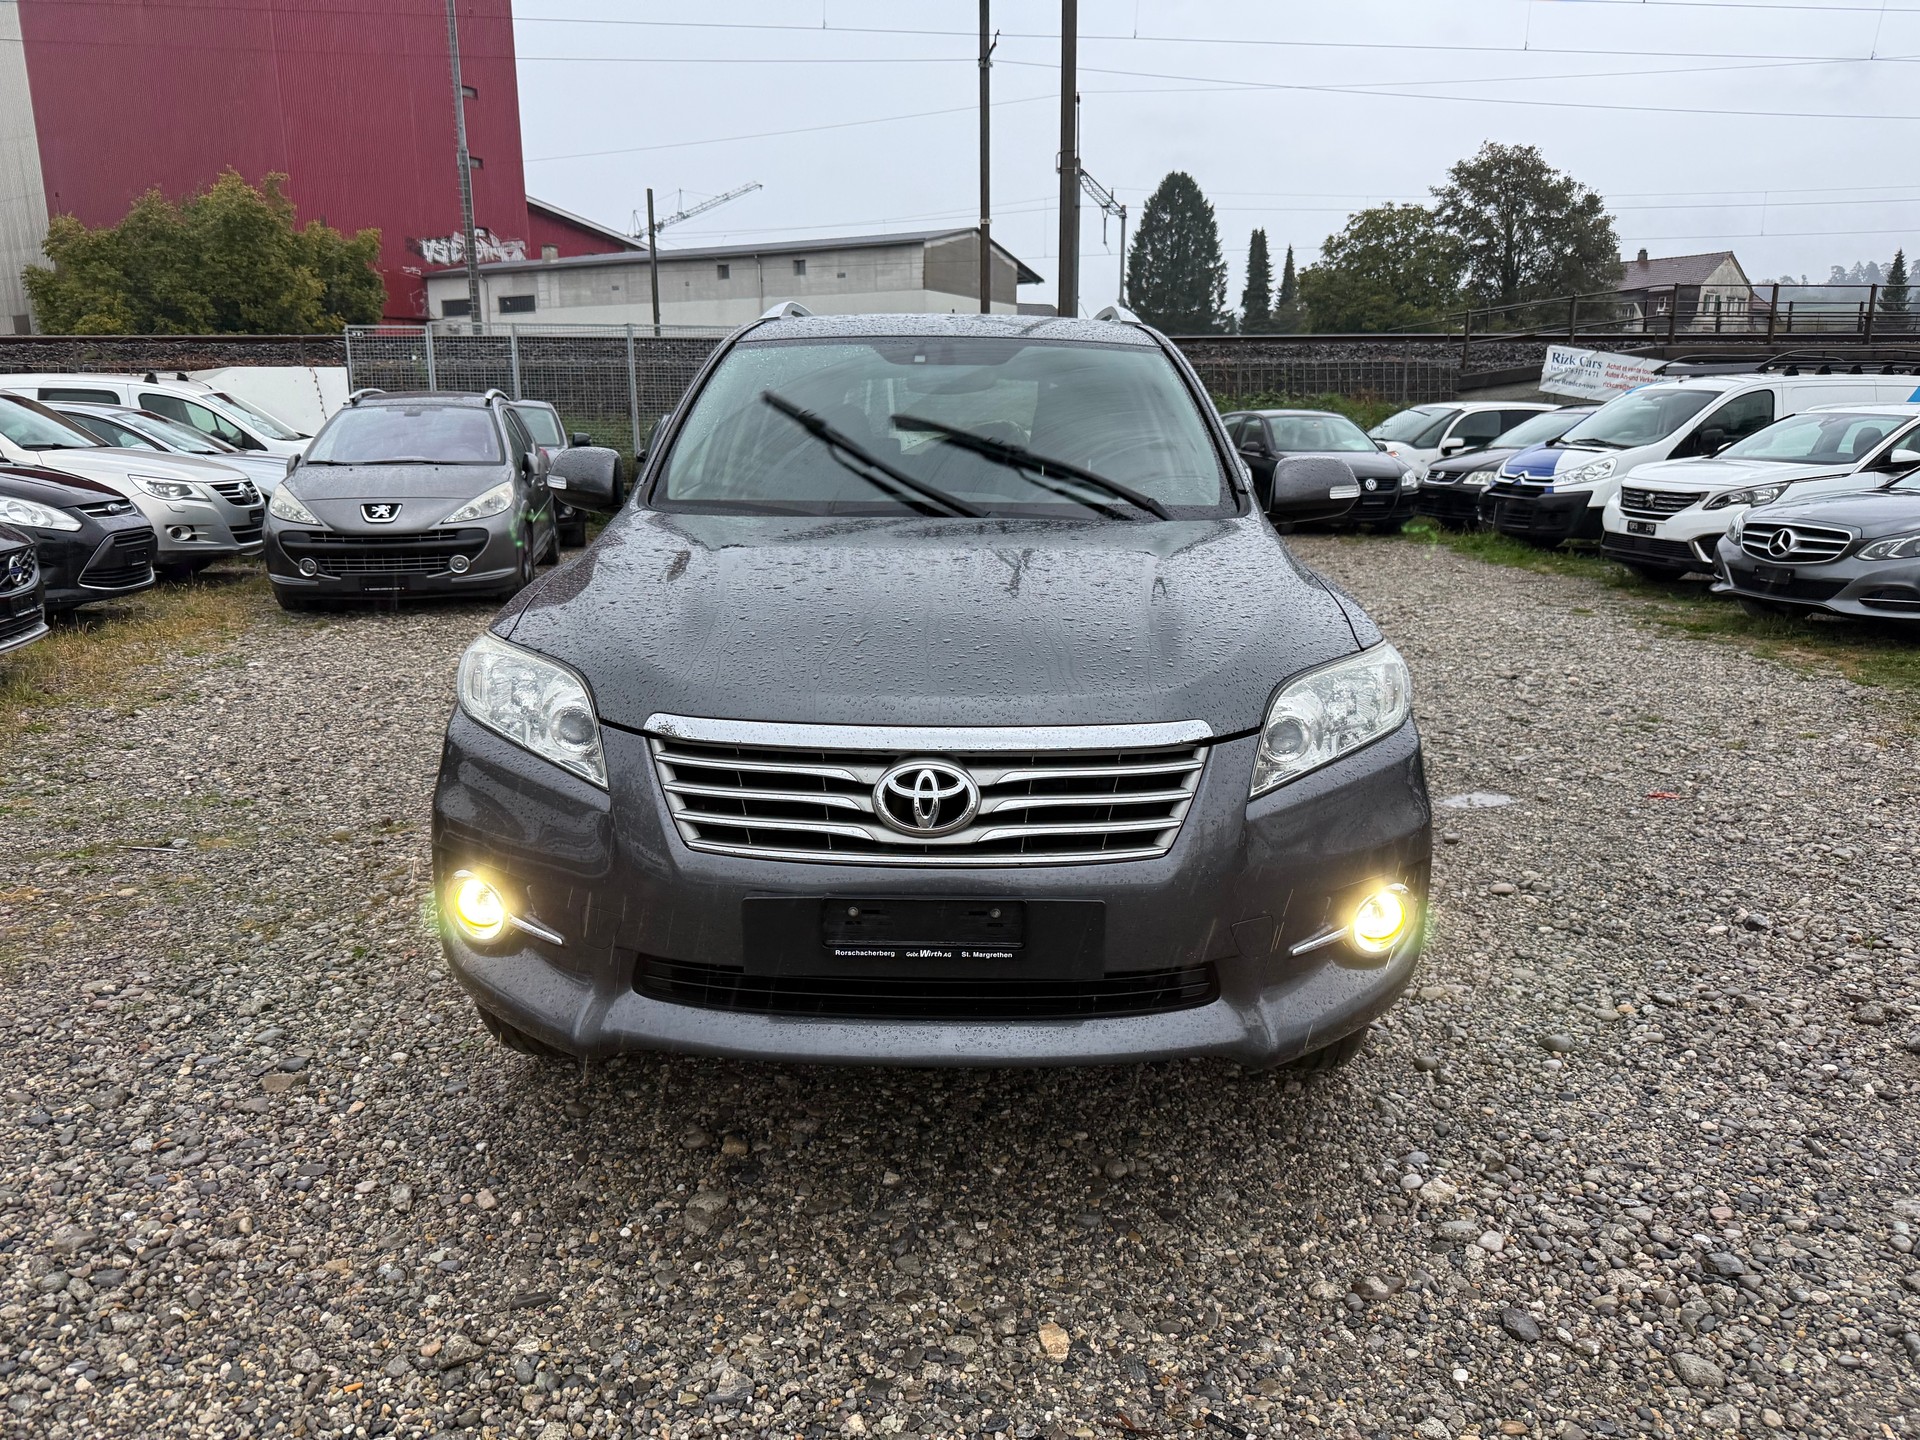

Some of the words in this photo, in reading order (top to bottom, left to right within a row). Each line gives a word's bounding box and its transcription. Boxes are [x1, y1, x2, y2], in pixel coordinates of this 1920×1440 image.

[1552, 352, 1576, 366] Rizk
[1580, 356, 1603, 369] Cars
[835, 949, 896, 958] Rorschacherberg
[920, 949, 943, 958] Wirth
[972, 951, 1013, 959] Margrethen
